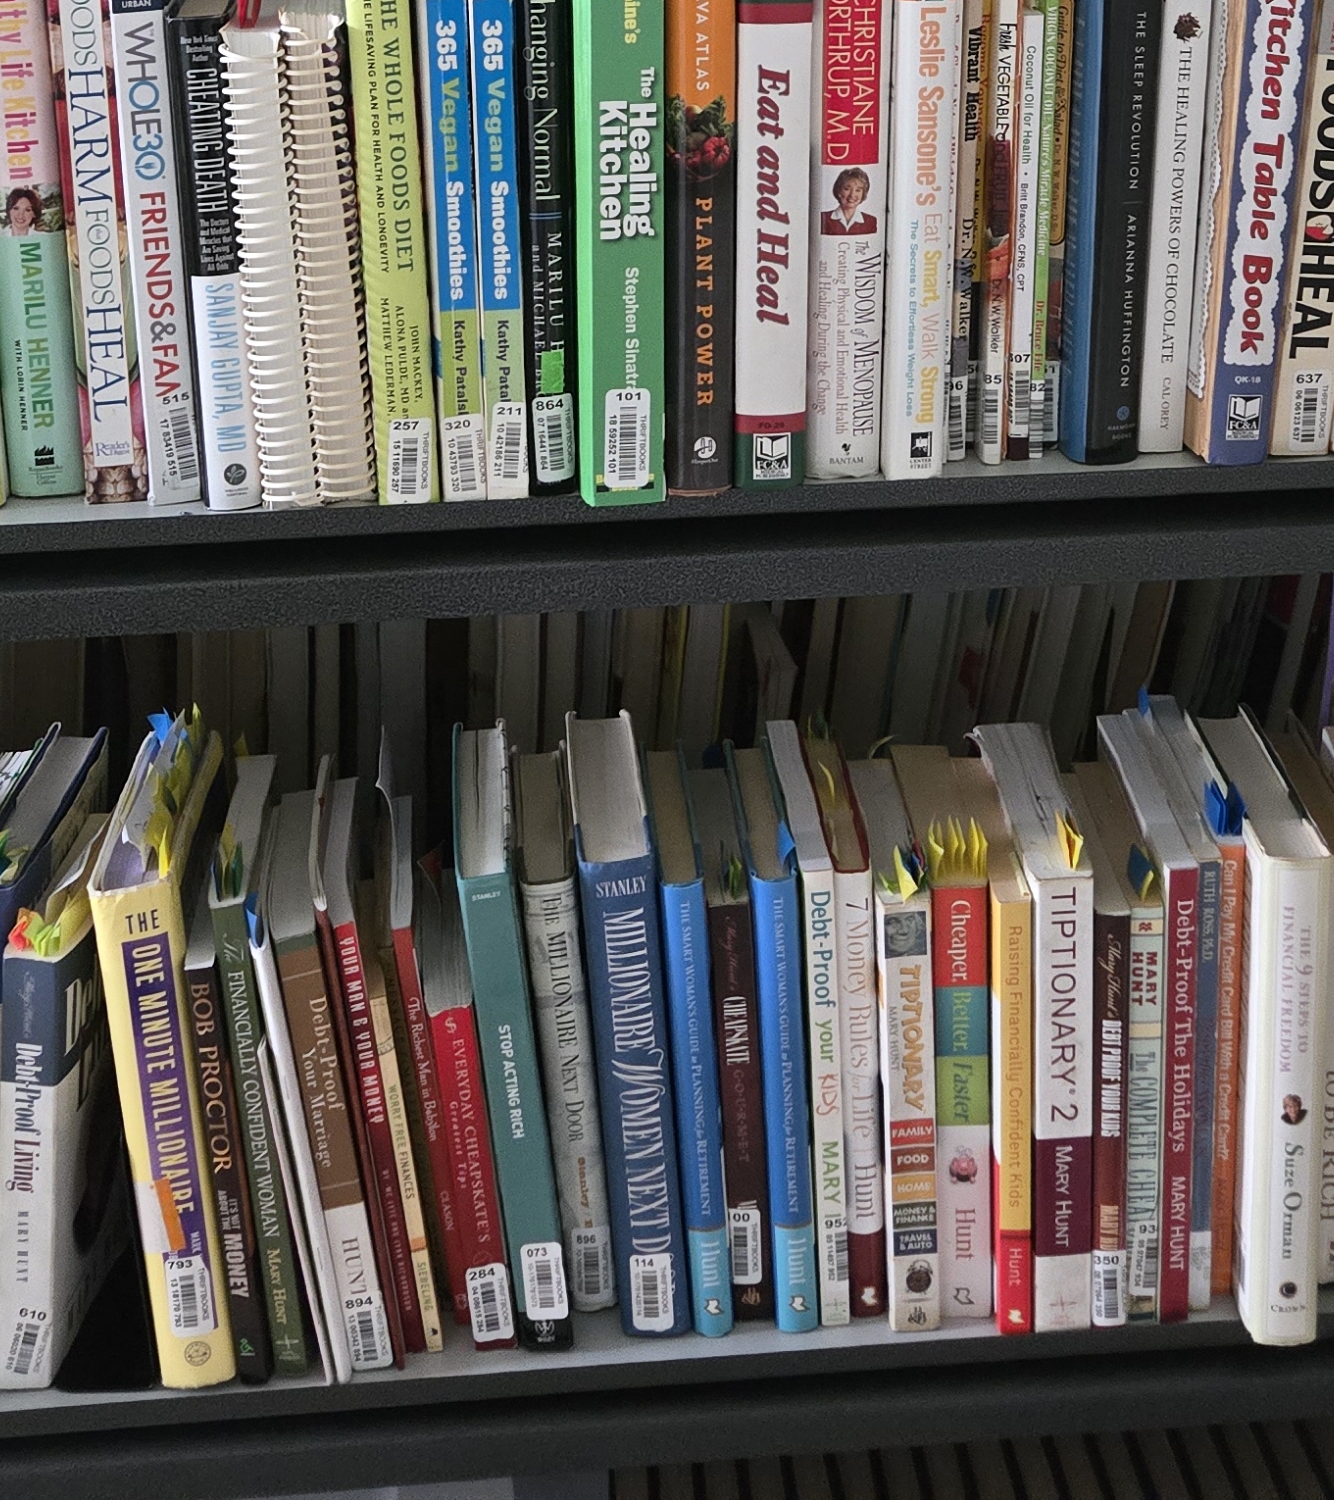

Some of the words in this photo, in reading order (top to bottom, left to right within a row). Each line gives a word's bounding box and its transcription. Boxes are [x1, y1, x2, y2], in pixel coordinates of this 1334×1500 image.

[383, 37, 405, 125] WHOLE
[435, 18, 458, 73] 365
[696, 36, 711, 92] ATLAS
[640, 67, 654, 99] The
[757, 64, 792, 131] Eat
[439, 79, 463, 174] Vegan
[825, 105, 849, 160] M.D.
[390, 130, 411, 211] FOODS
[599, 101, 623, 244] Kitchen
[624, 102, 656, 238] Healing
[755, 144, 791, 224] and
[1253, 133, 1286, 241] Table
[394, 215, 415, 273] DIET
[444, 180, 465, 300] Smoothies
[695, 195, 715, 290] PLANT
[755, 228, 792, 325] Heal
[1240, 255, 1269, 357] Book
[696, 304, 715, 408] POWER
[1296, 374, 1322, 384] 637
[394, 420, 420, 432] 257
[616, 392, 643, 401] 101
[829, 455, 863, 464] BANTAM
[125, 909, 160, 933] THE
[809, 890, 833, 1008] Debt-Proof
[133, 943, 158, 988] ONE
[138, 995, 170, 1074] MINUTE
[190, 982, 213, 1036] BOB
[813, 1018, 835, 1065] your
[198, 1041, 235, 1177] PROCTOR
[817, 1074, 841, 1115] KIDS
[1051, 1102, 1078, 1122] 2
[151, 1075, 196, 1216] MILLIONAIRE
